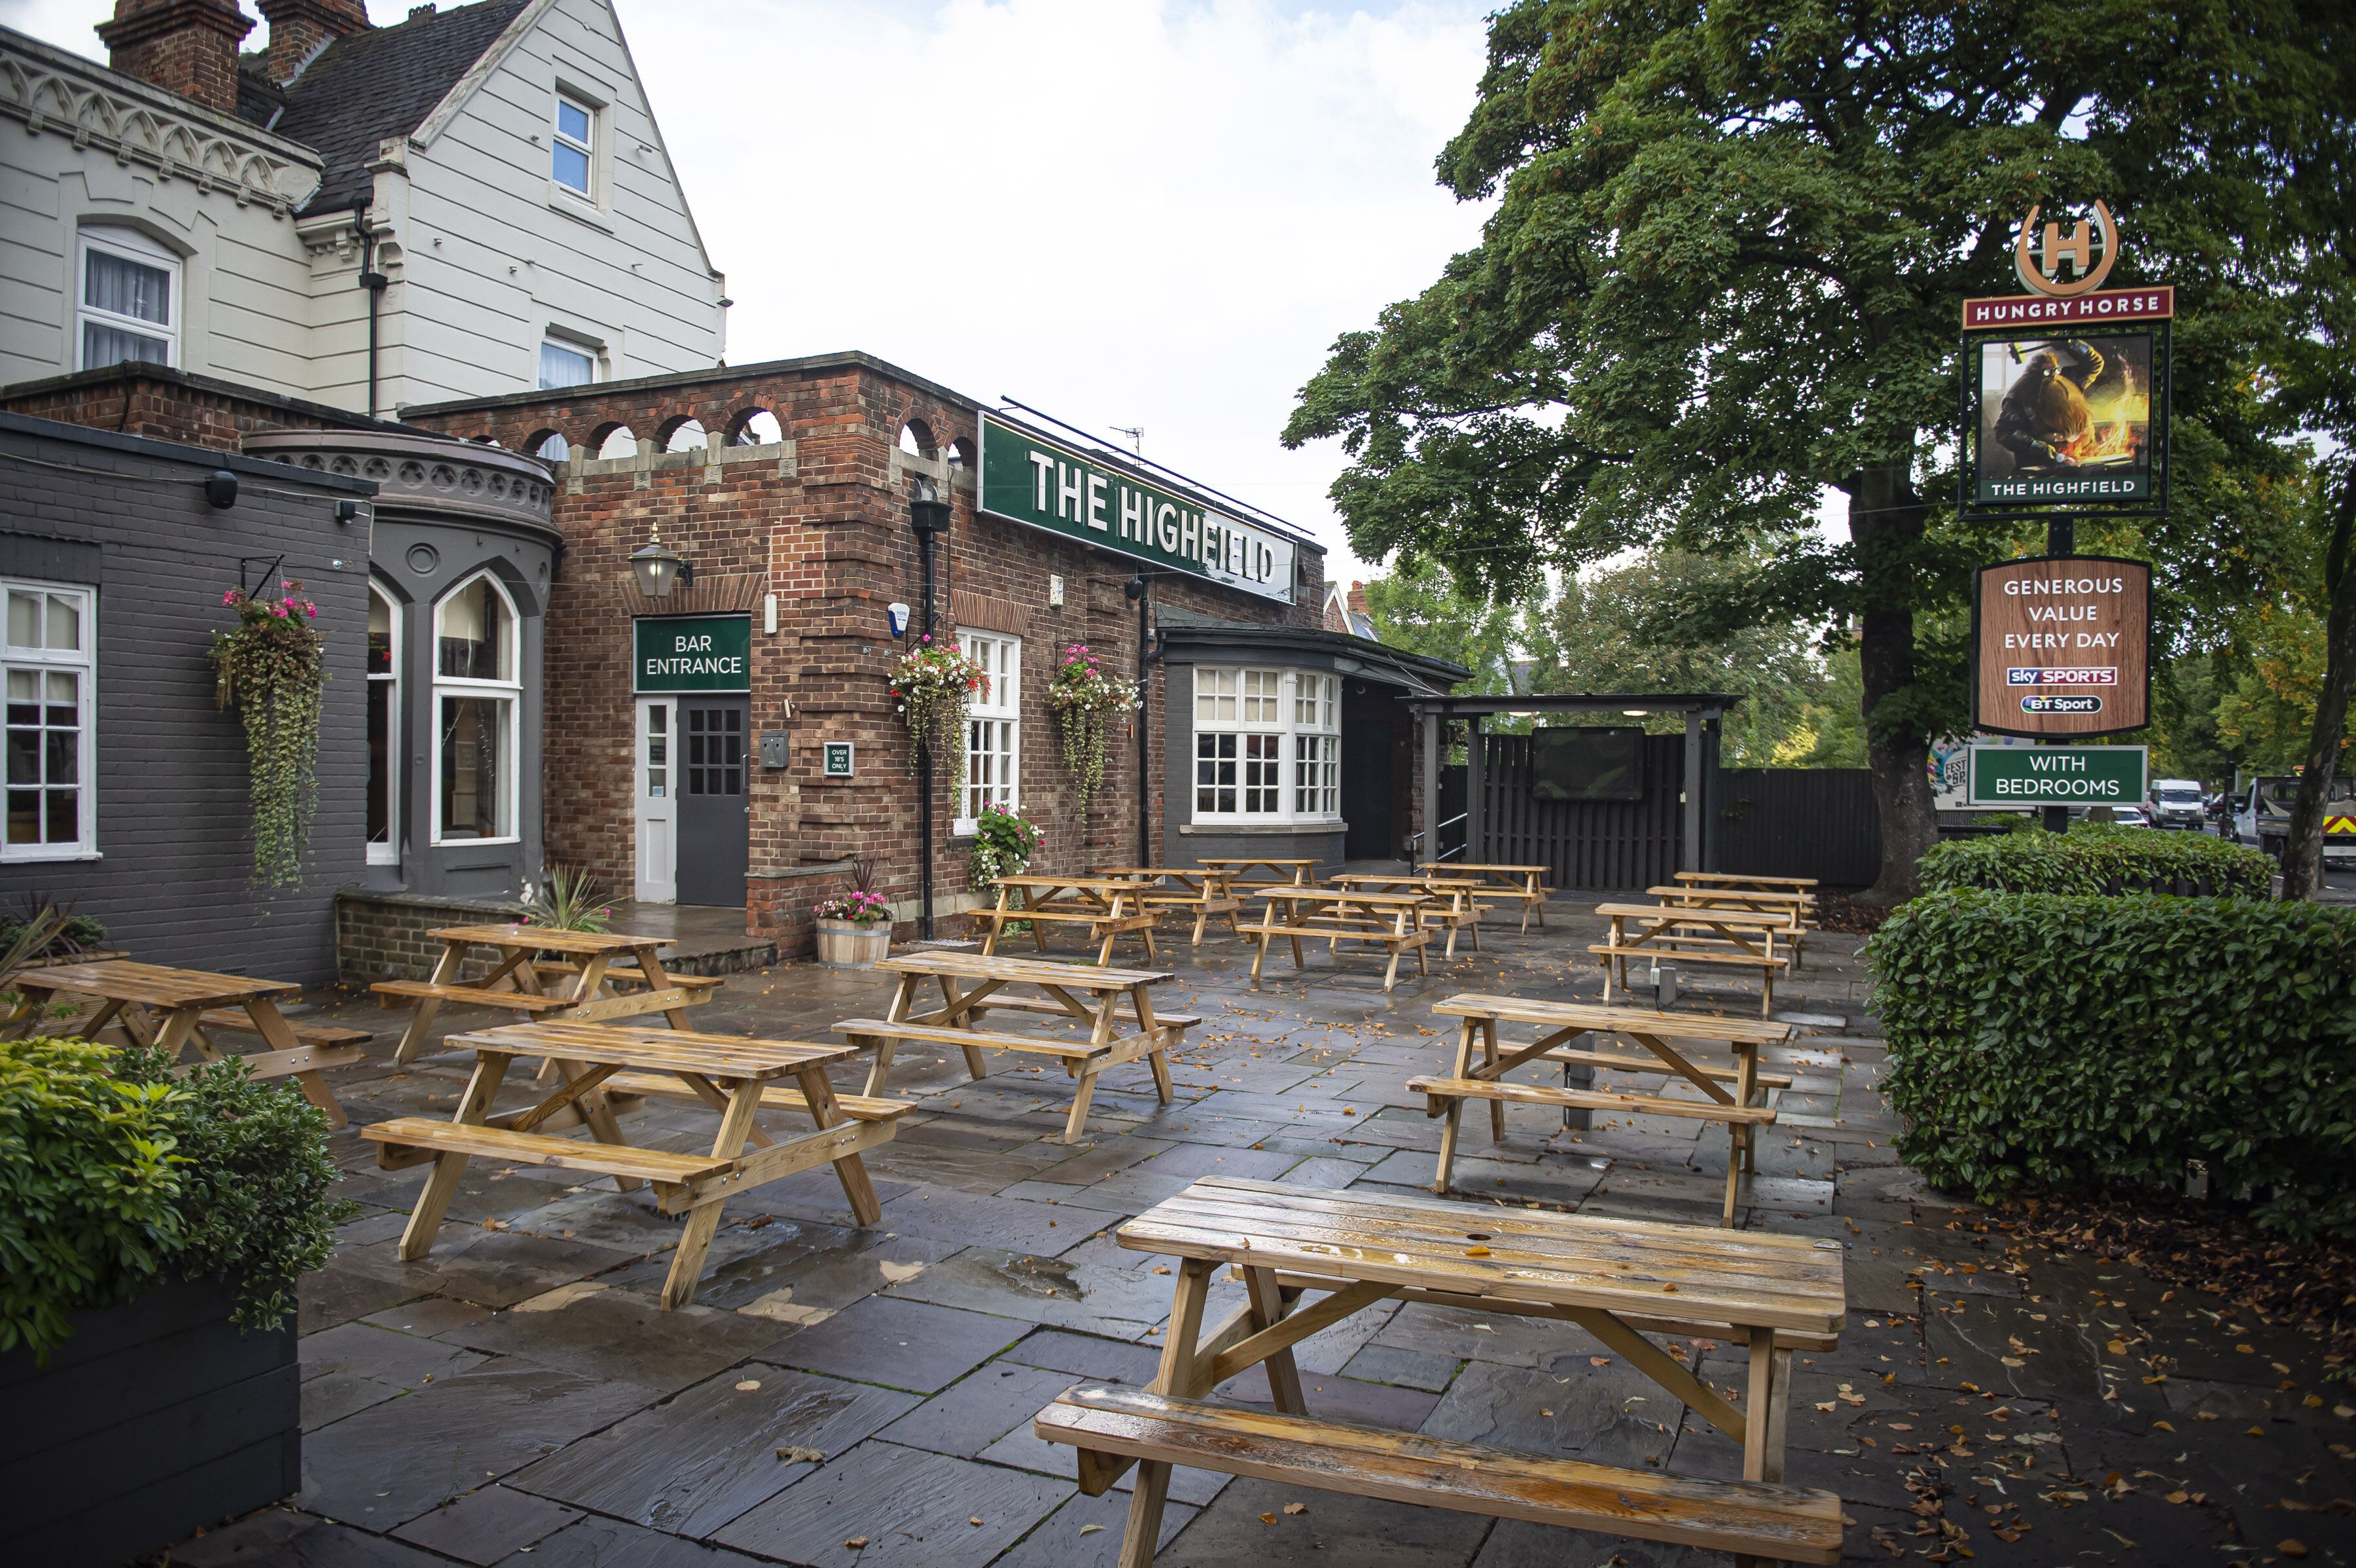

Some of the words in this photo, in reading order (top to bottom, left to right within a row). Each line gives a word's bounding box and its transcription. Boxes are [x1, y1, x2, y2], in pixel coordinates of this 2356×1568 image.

[1976, 302, 2072, 321] HUNGRY
[2080, 296, 2158, 314] HORSE
[1991, 483, 2026, 496] THE
[2033, 480, 2135, 495] HIGHFIELD
[1030, 450, 1107, 531] THE
[1121, 486, 1276, 584] HIGHFIELD
[2004, 578, 2122, 596] GENEROUS
[2029, 606, 2097, 621] VALUE
[675, 635, 711, 652] BAR
[2005, 633, 2069, 649] EVERY
[2077, 632, 2120, 648] DAY
[647, 656, 742, 675] ENTRANCE
[2011, 669, 2038, 685] sky
[2042, 670, 2113, 683] SPORTS
[2031, 700, 2053, 709] BT
[2054, 698, 2093, 711] Sport
[2029, 756, 2085, 772] WITH
[1996, 778, 2120, 796] BEDROOMS
